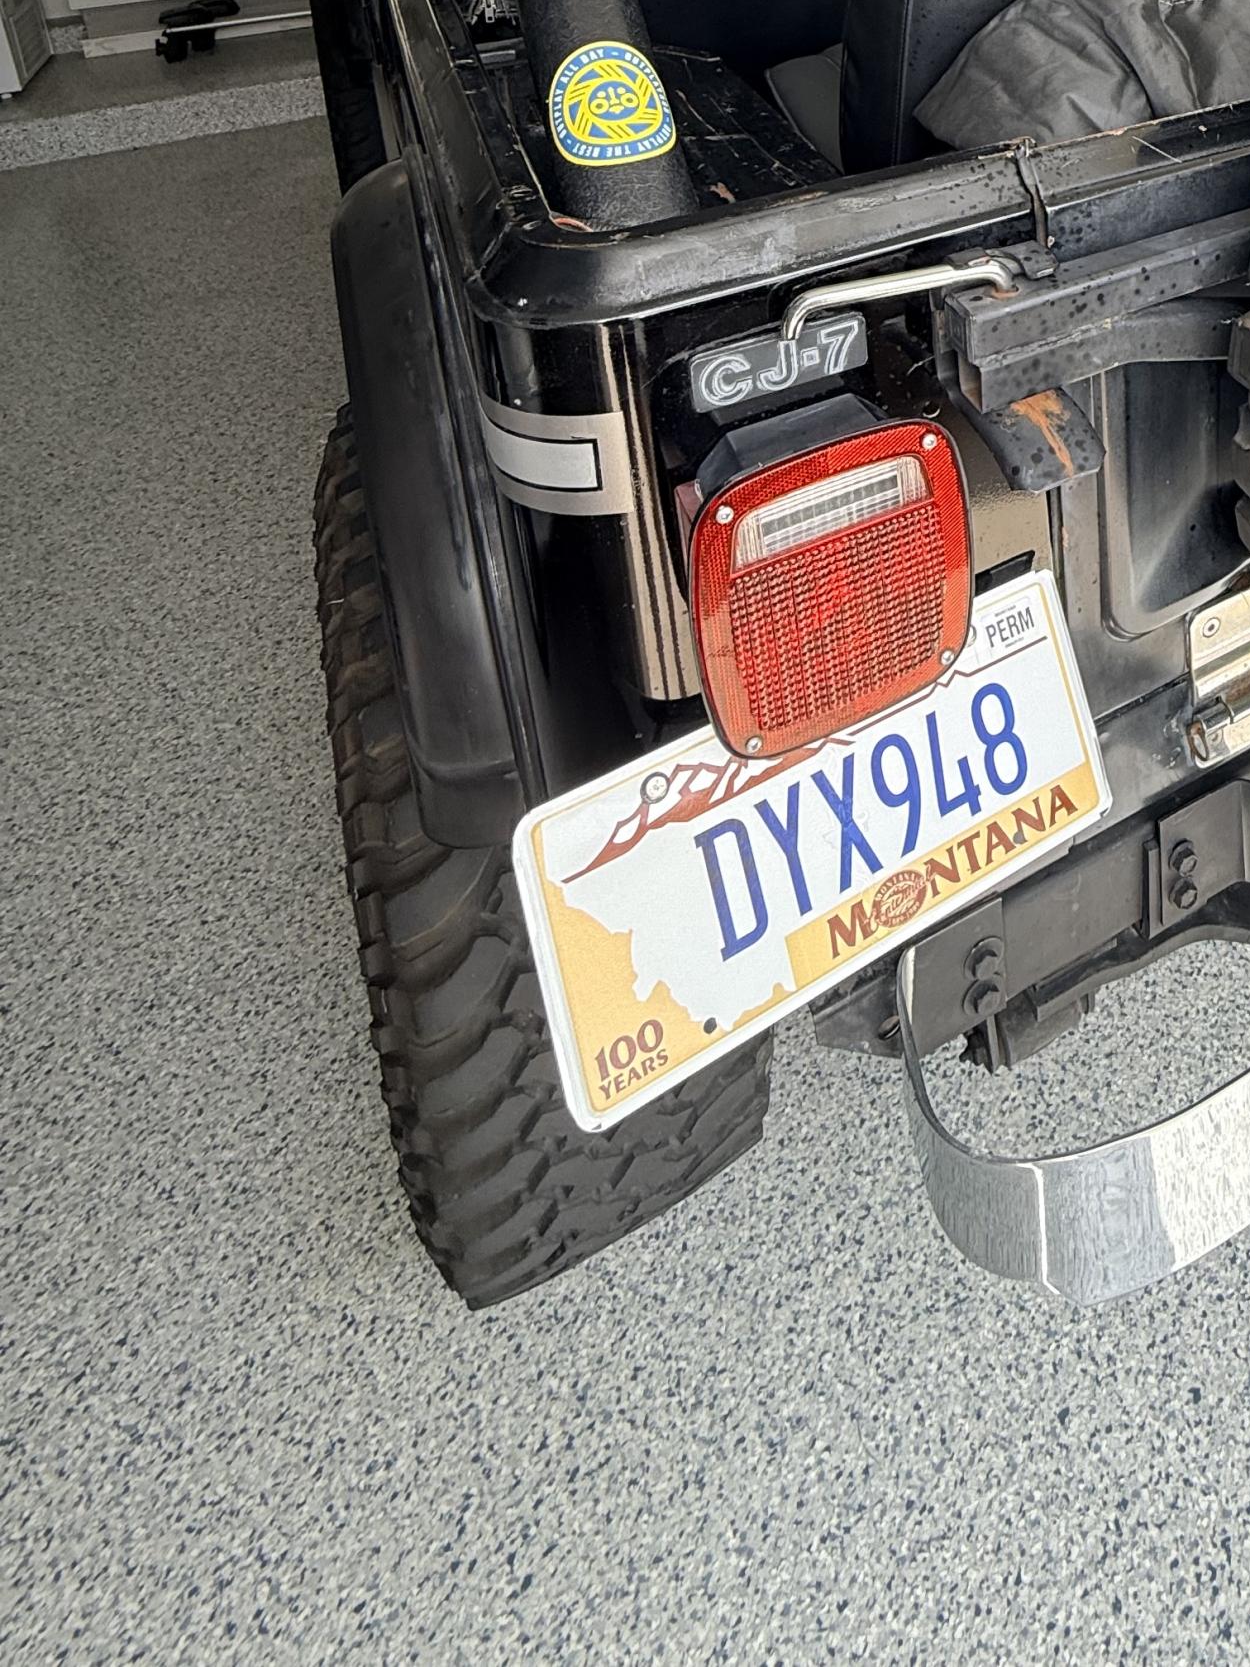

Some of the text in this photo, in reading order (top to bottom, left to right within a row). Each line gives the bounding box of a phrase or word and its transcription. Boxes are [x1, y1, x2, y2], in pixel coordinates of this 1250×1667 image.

[552, 47, 605, 140] OUTPLAY ALL DAY
[571, 143, 599, 159] BEST
[605, 144, 632, 159] THE
[700, 320, 859, 406] CJ-7
[985, 605, 1035, 648] PERM
[694, 682, 1028, 962] DYX948
[595, 1019, 664, 1082] 100
[598, 1048, 669, 1100] YEARS
